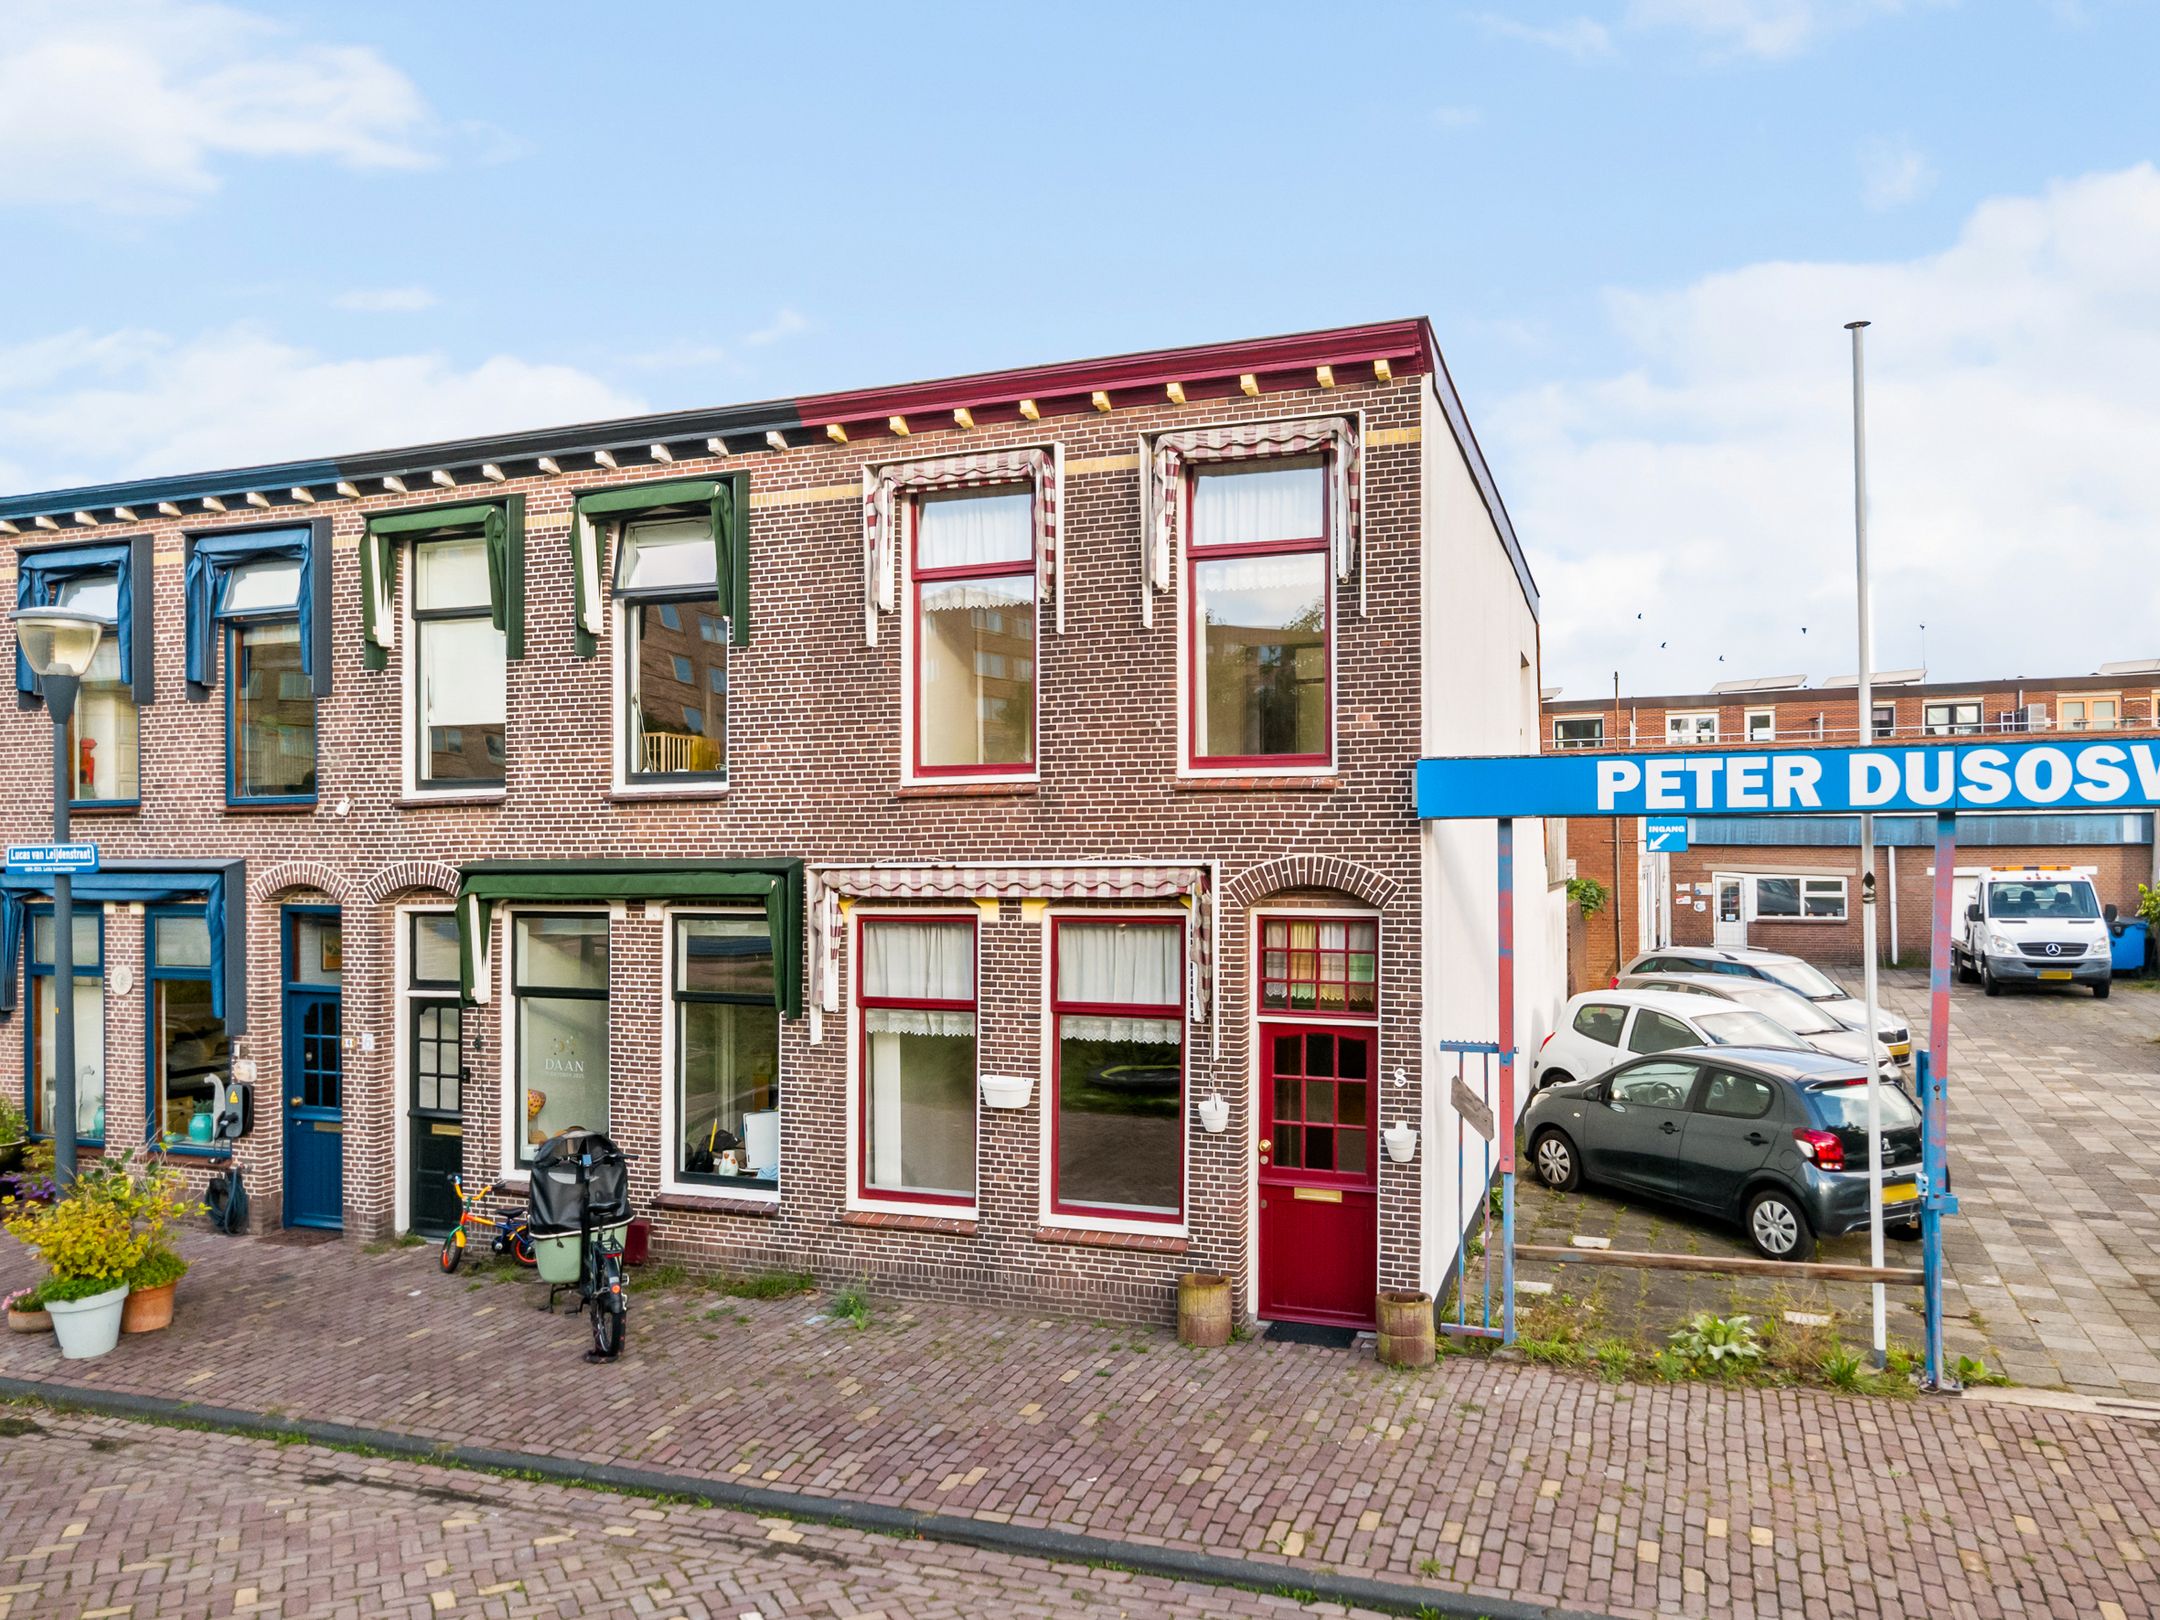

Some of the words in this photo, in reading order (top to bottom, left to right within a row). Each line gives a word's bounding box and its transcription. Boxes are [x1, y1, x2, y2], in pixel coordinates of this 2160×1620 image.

[1597, 755, 1823, 811] PETER
[1648, 825, 1686, 833] INGANG
[10, 848, 31, 860] Lucas
[32, 850, 45, 860] van
[545, 1058, 584, 1072] DAAN
[1394, 1067, 1407, 1088] 8
